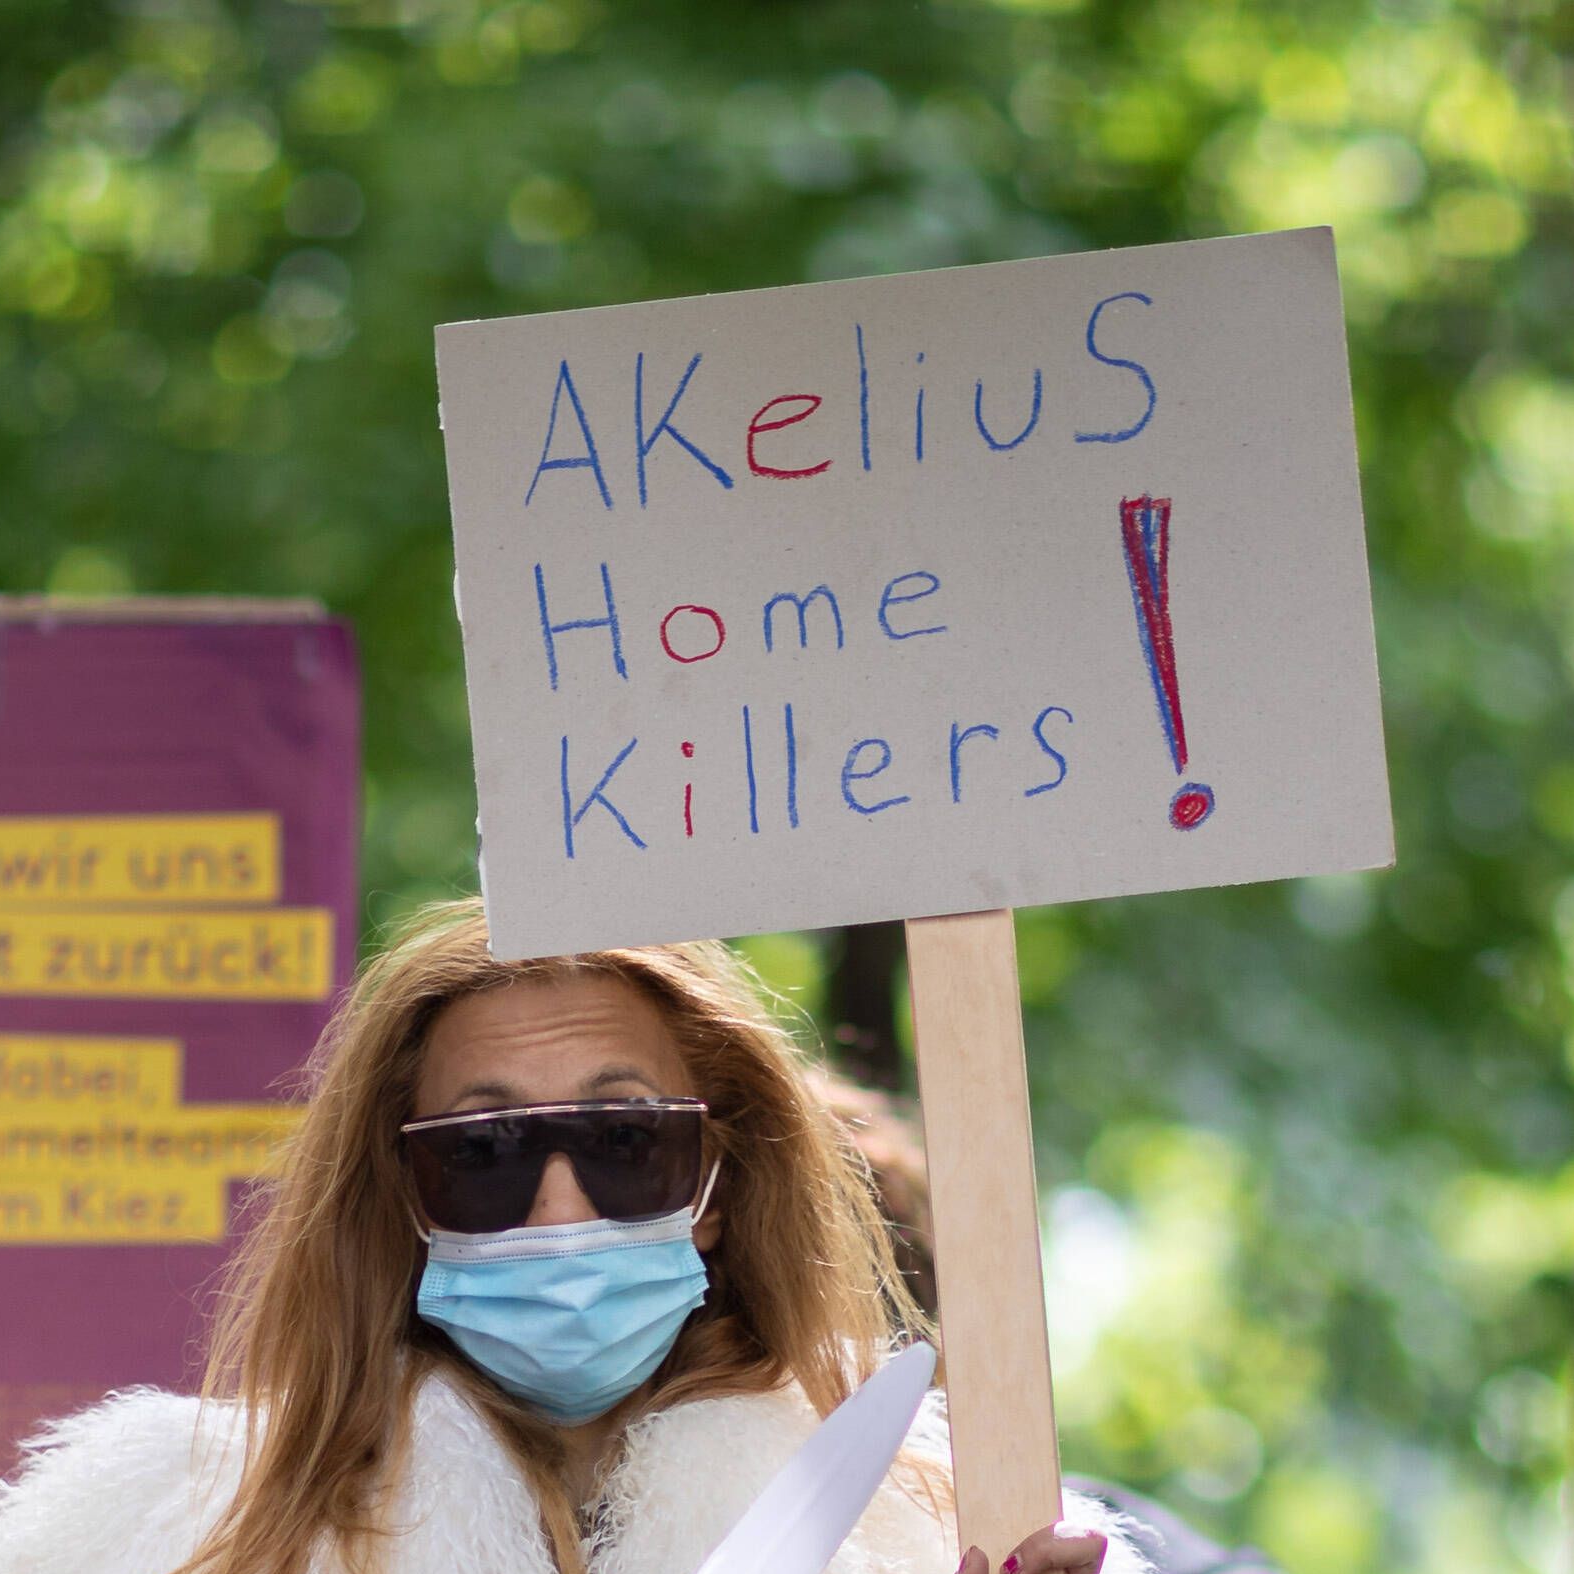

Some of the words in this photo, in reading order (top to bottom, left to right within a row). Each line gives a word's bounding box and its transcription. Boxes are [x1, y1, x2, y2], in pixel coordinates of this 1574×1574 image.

[534, 562, 947, 692] Home
[131, 844, 259, 890] uns
[44, 922, 317, 988] zurück!
[61, 1183, 200, 1228] Kiez.
